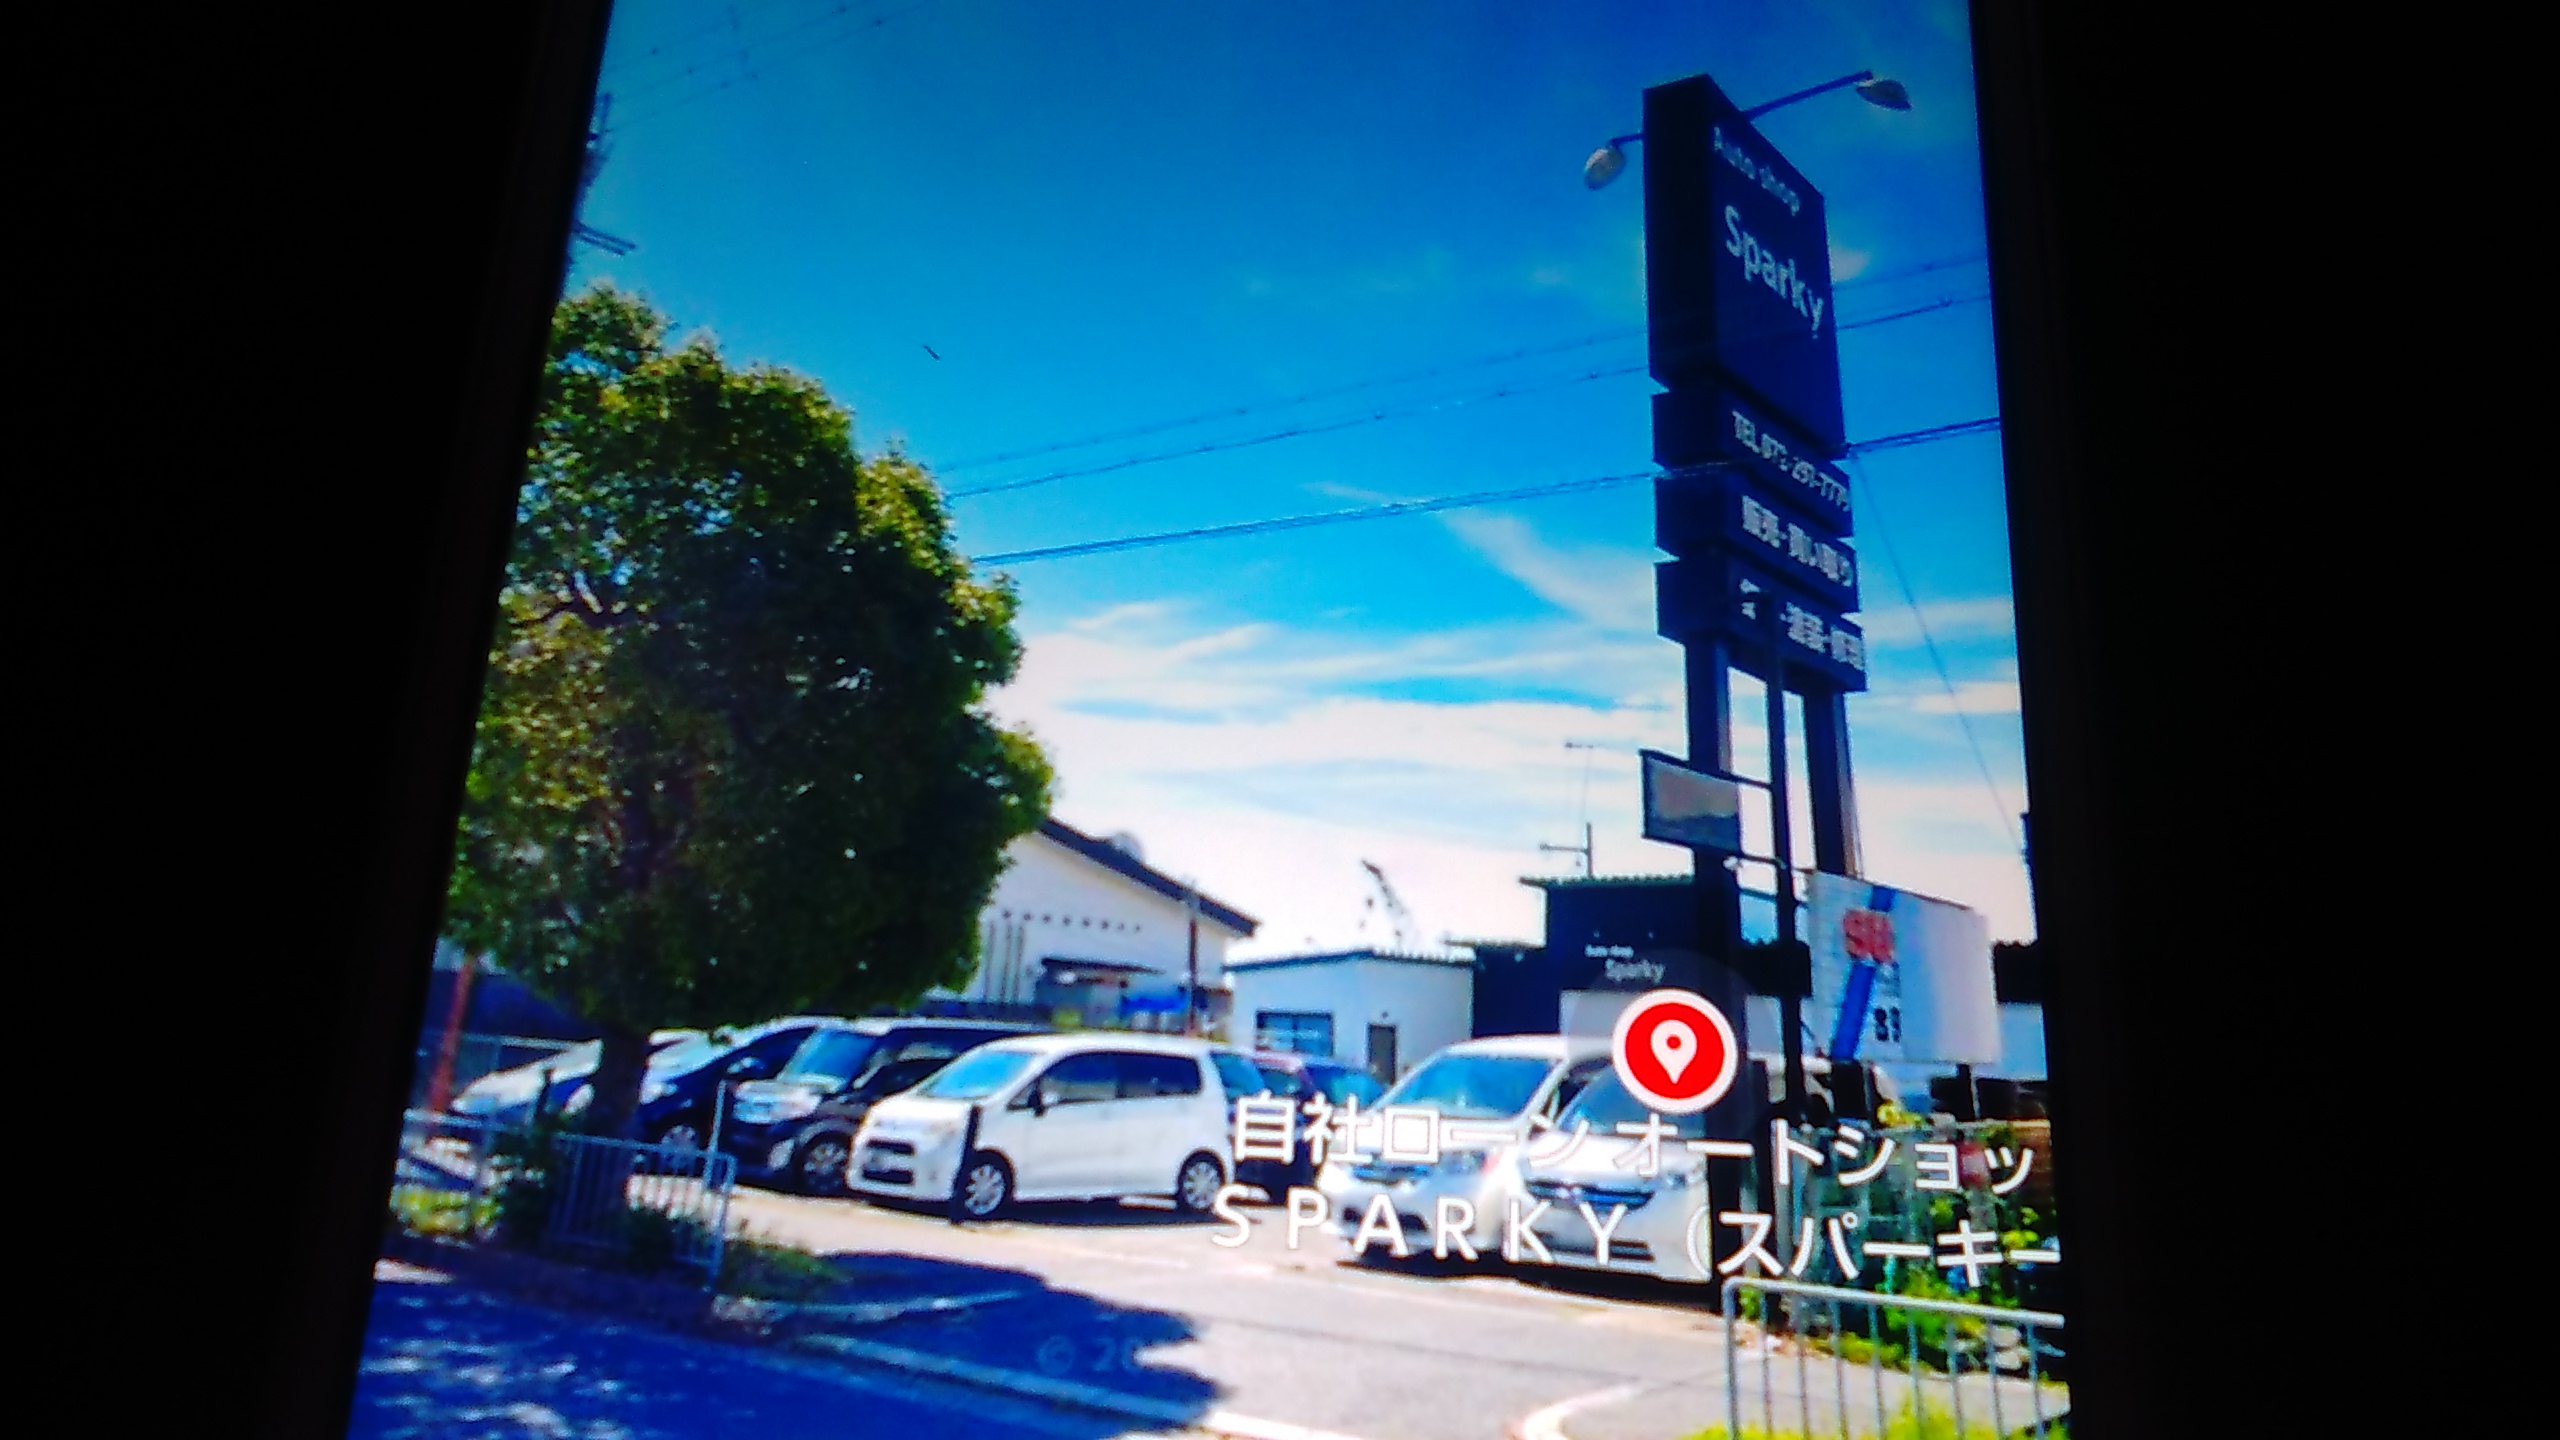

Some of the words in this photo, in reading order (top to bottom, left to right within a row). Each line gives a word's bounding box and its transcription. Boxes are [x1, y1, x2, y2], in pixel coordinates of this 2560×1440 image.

[1713, 126, 1755, 179] Auto
[1759, 165, 1800, 216] shop
[1725, 205, 1825, 339] Sparky
[1605, 958, 1666, 985] Sparky
[1234, 1090, 1590, 1170] 自社ローン
[1211, 1183, 1629, 1266] SPARKY
